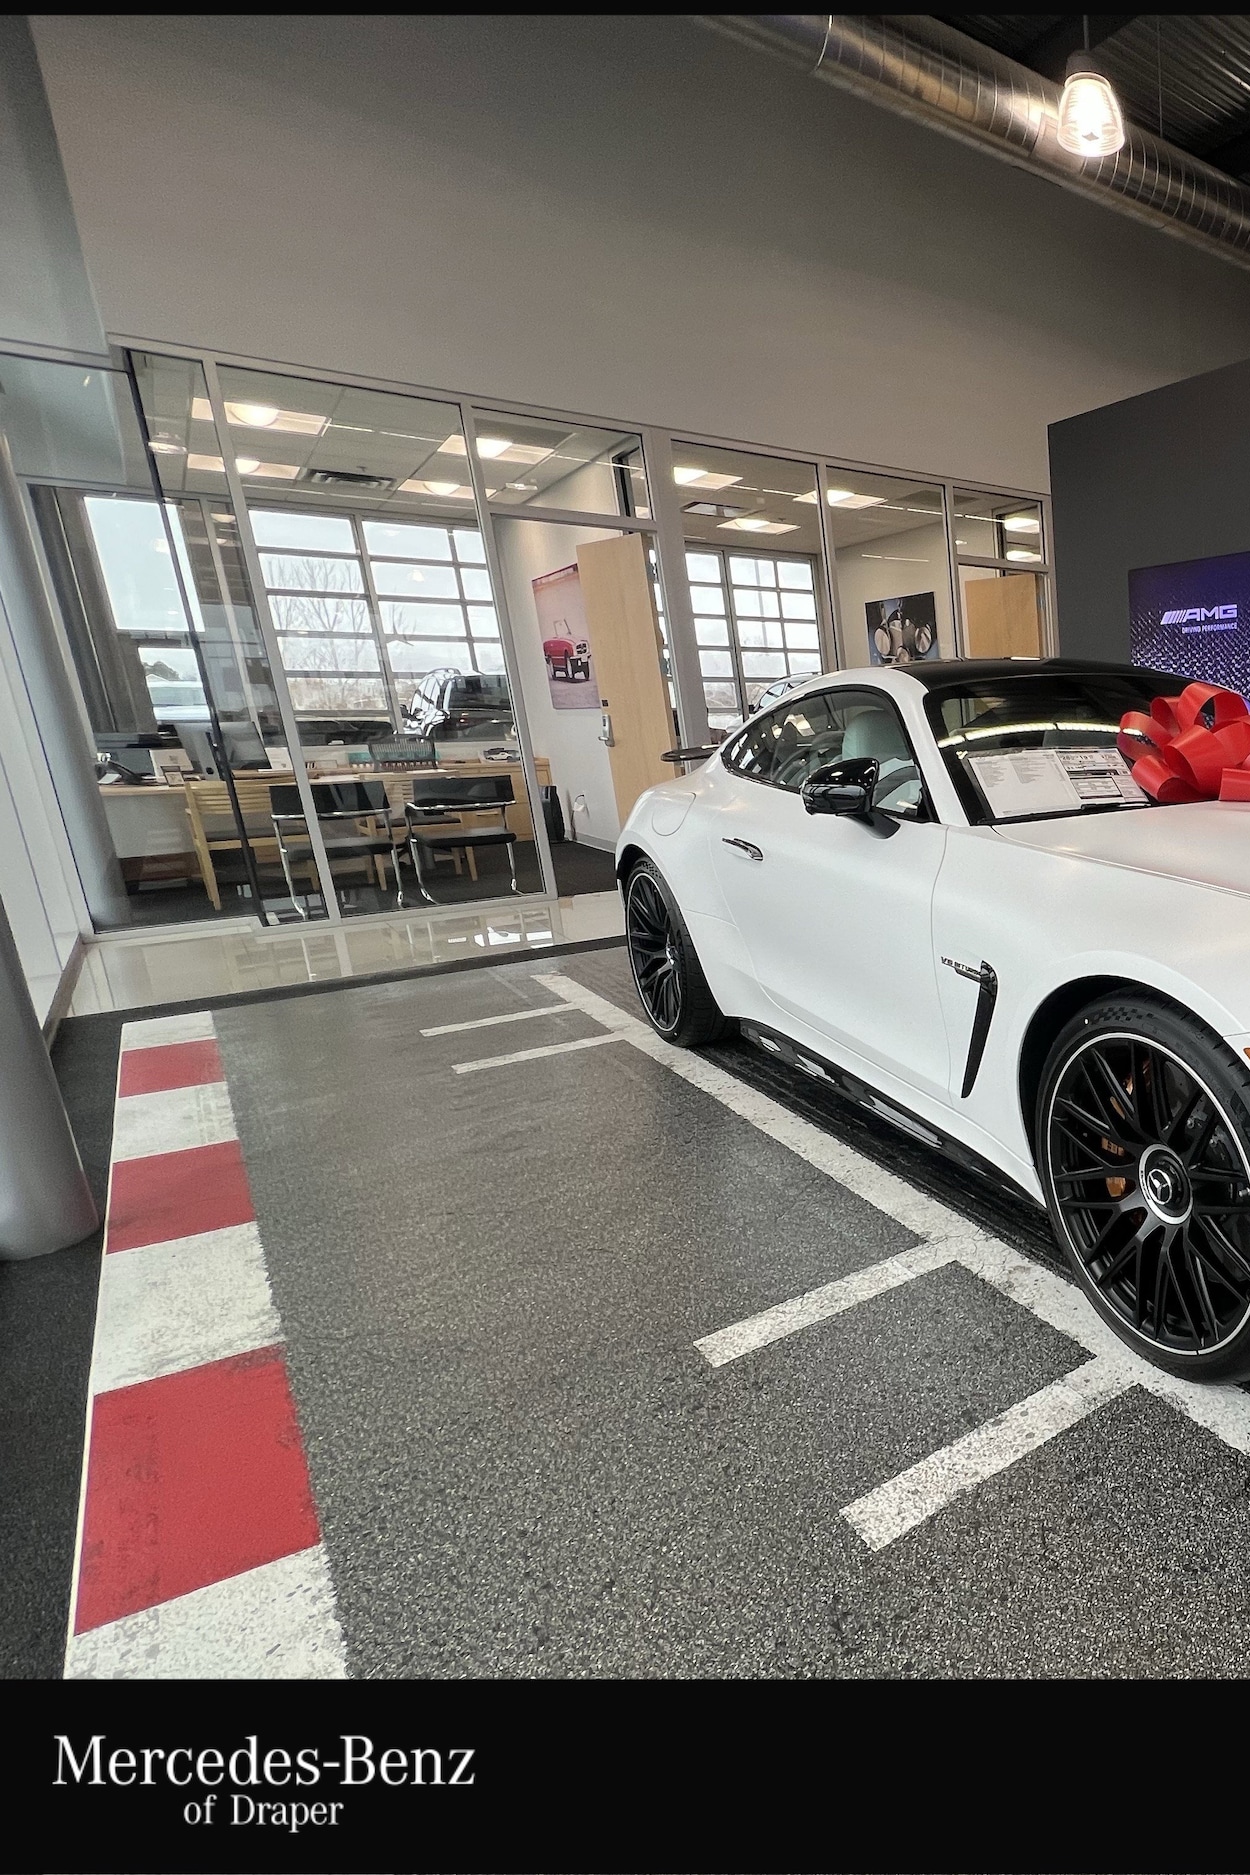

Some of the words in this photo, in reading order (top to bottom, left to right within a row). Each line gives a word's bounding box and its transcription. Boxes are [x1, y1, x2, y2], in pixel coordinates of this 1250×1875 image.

[1182, 604, 1238, 623] AMG
[1182, 625, 1201, 634] DRIVING
[1201, 622, 1238, 632] PERFORMANCE
